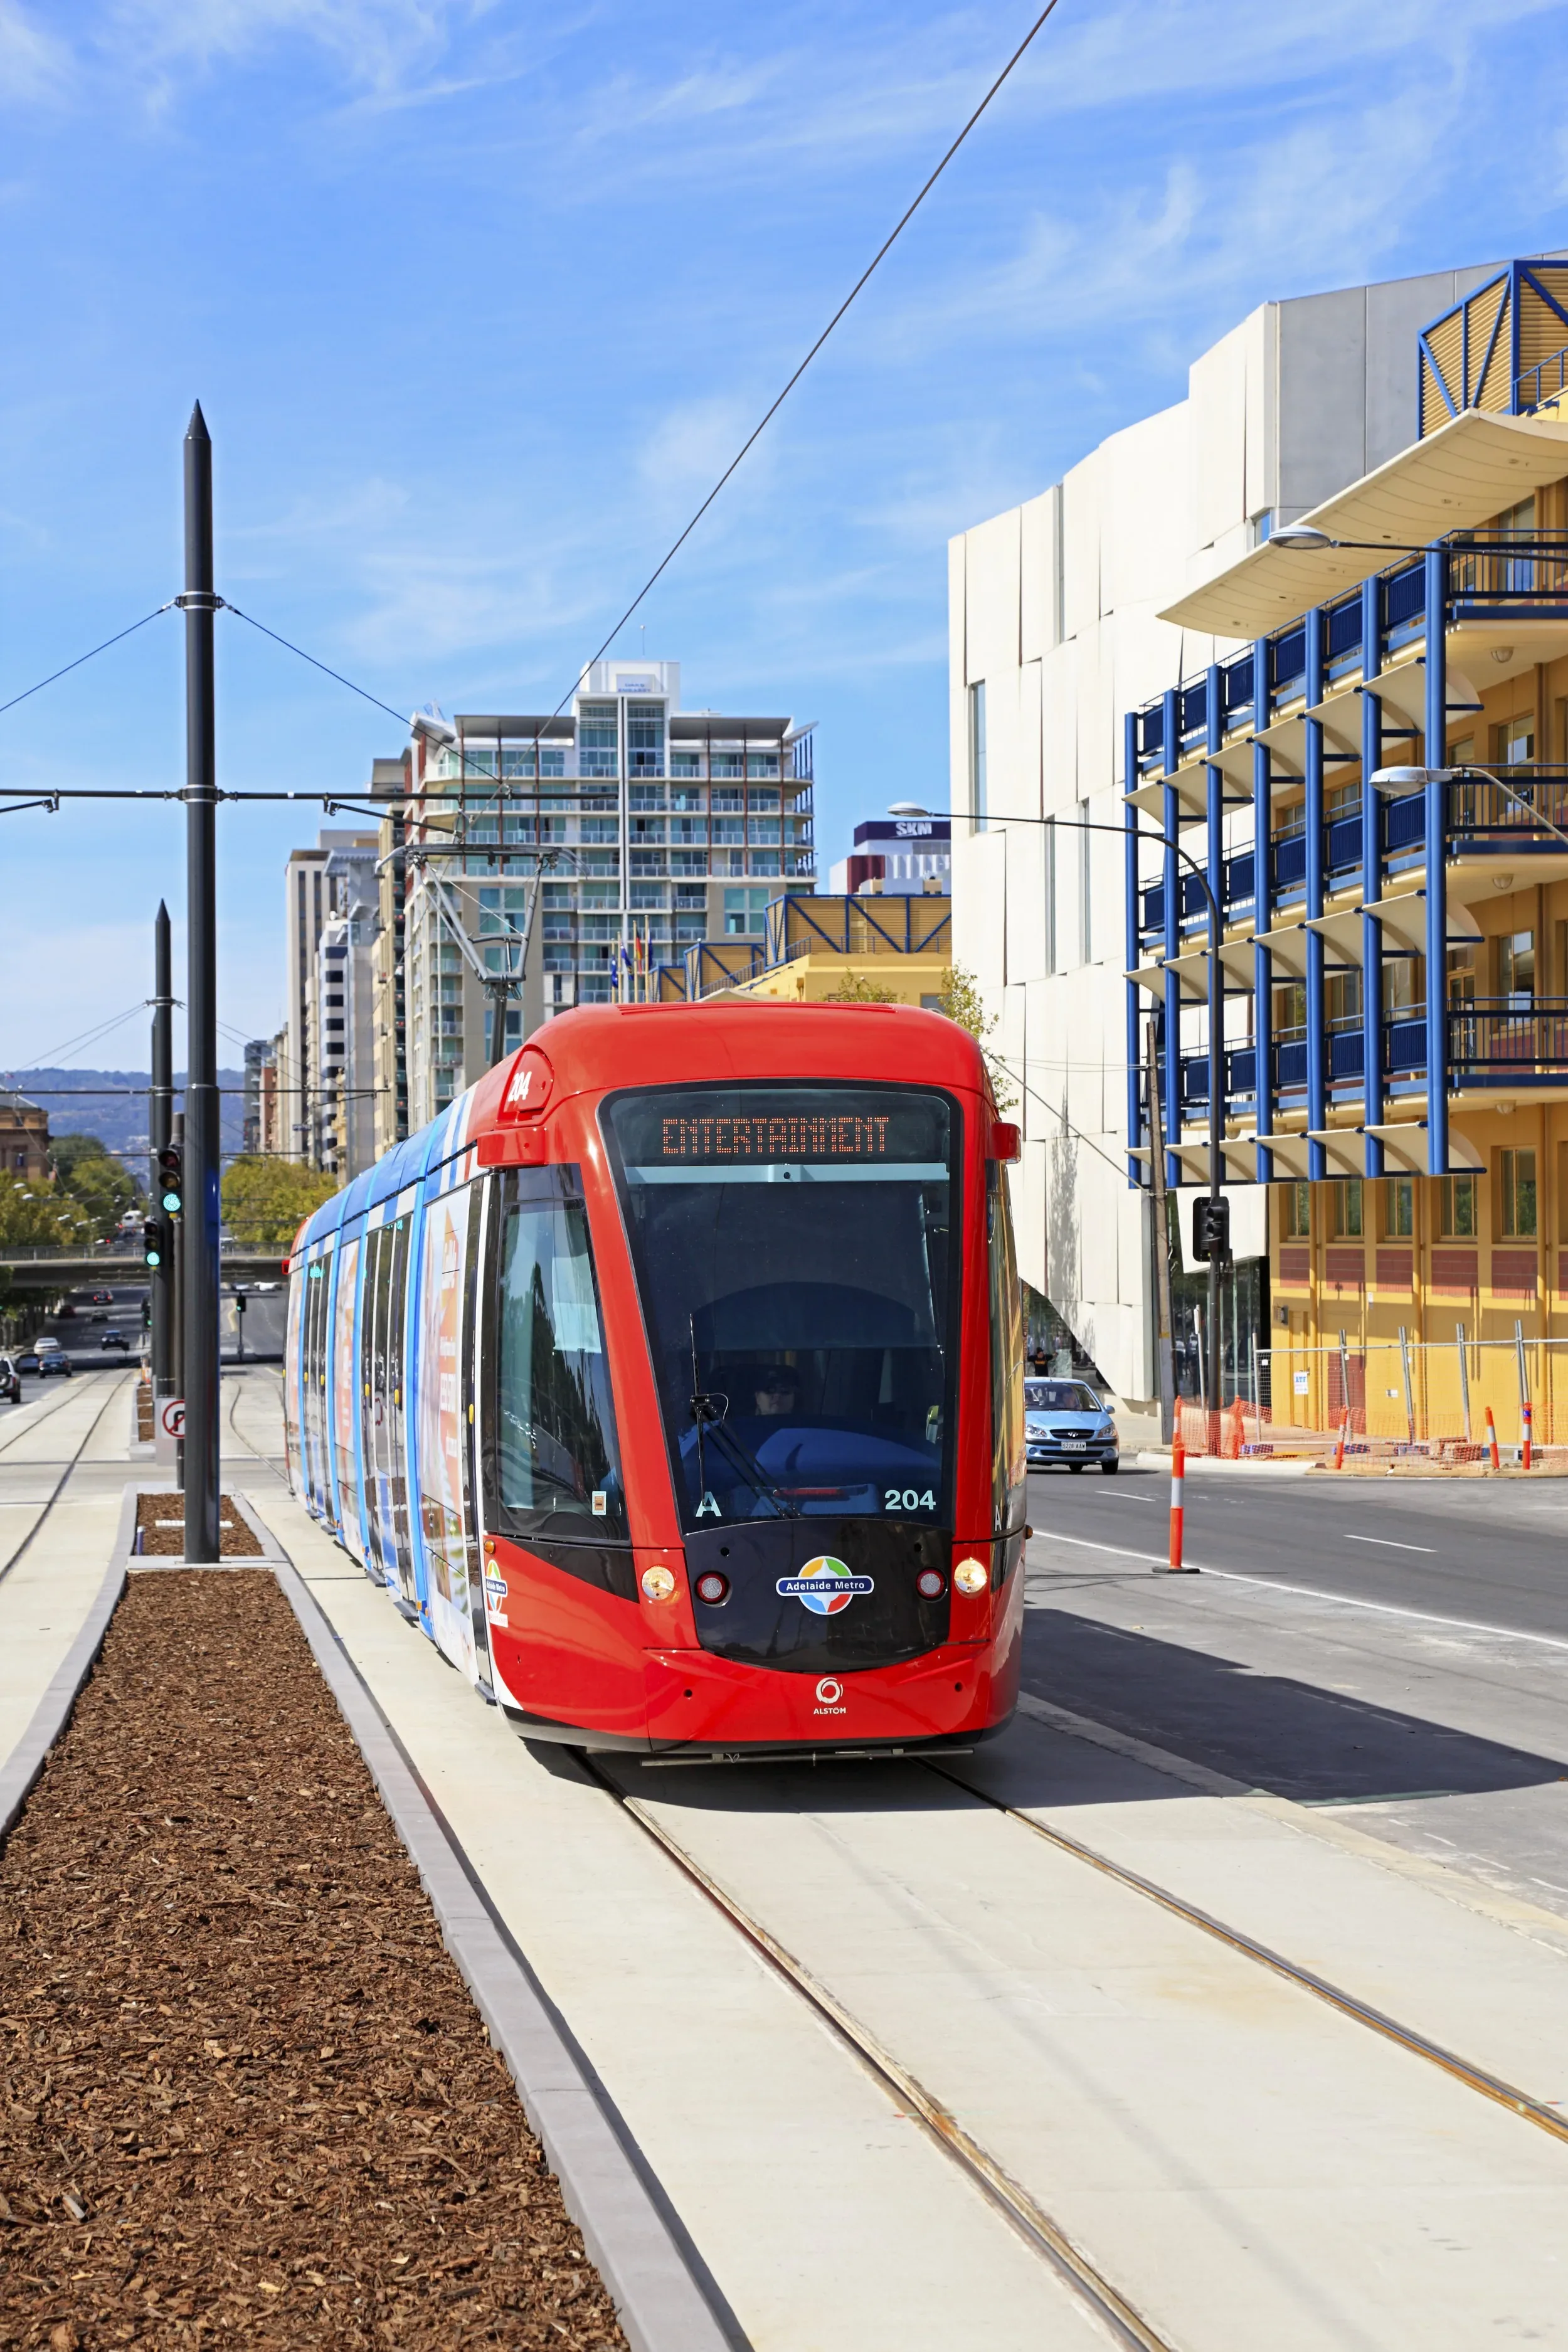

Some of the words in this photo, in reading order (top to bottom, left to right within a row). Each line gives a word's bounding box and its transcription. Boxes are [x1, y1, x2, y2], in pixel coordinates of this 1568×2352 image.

[896, 822, 932, 835] SKM
[508, 1071, 532, 1102] 204
[663, 1116, 889, 1154] ENTERTAINMENT
[696, 1491, 722, 1517] A
[884, 1489, 936, 1510] 204
[995, 1505, 1002, 1531] A
[786, 1581, 831, 1591] Adelaide
[835, 1581, 865, 1589] Metro
[813, 1707, 846, 1715] ALSTOM
